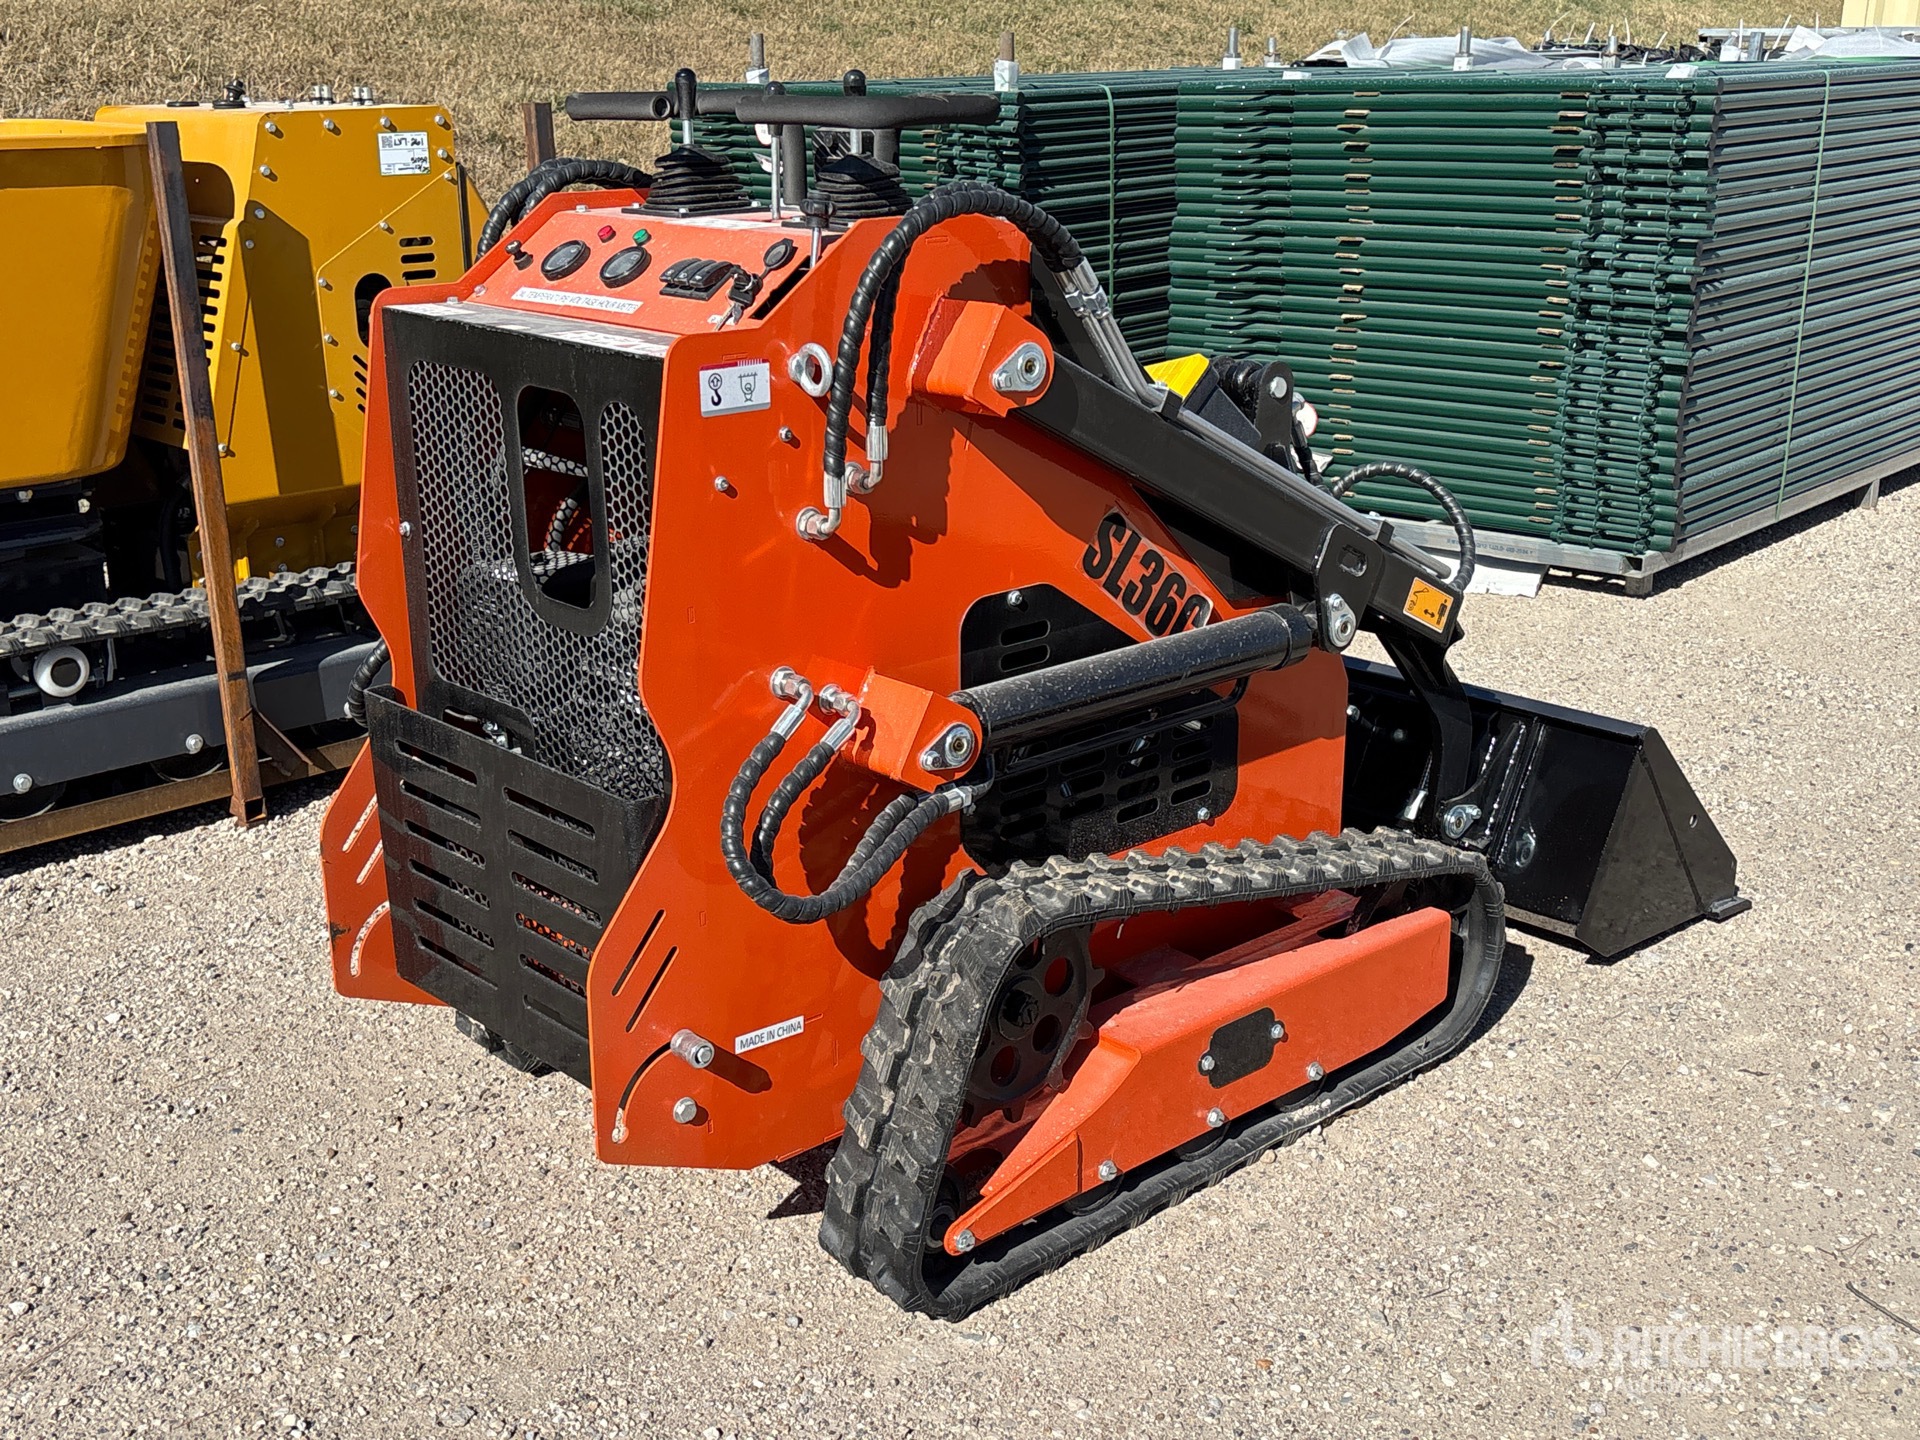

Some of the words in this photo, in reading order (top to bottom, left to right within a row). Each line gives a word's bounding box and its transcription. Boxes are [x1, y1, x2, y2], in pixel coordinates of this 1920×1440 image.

[740, 1032, 765, 1050] MADE
[766, 1029, 776, 1042] IN
[776, 1020, 802, 1038] CHINA
